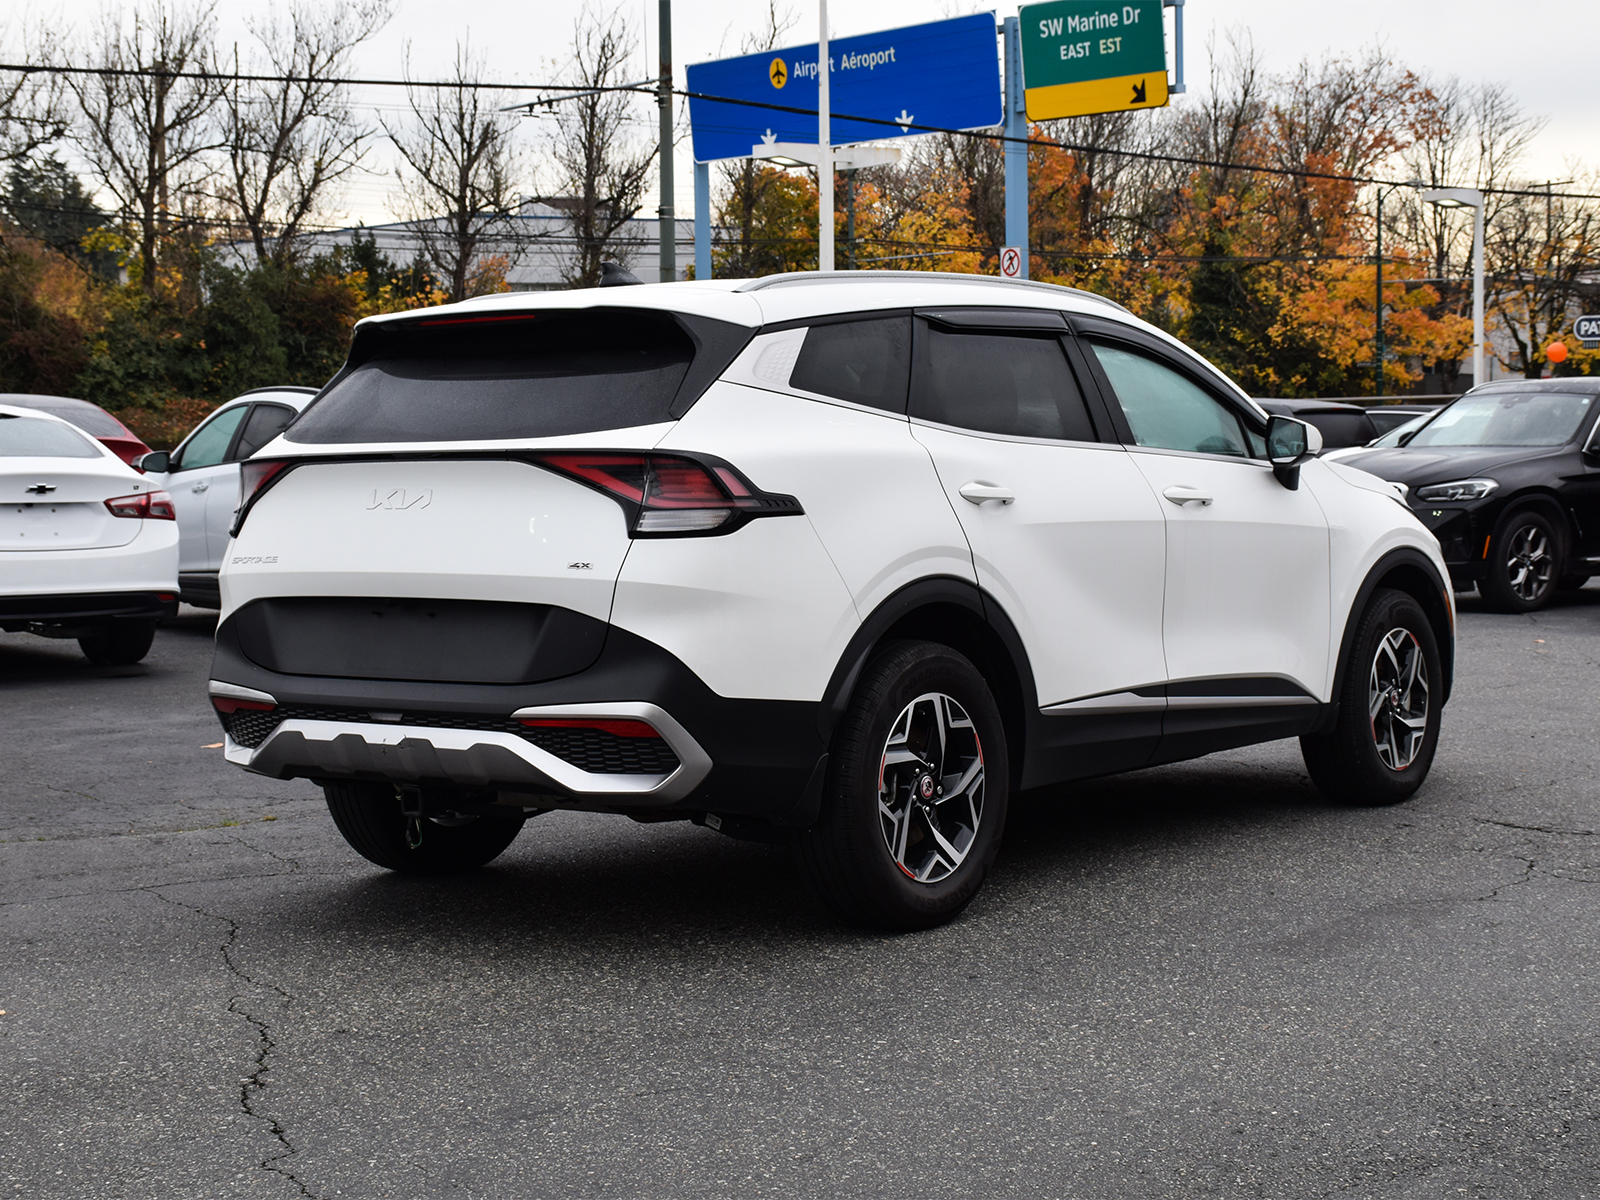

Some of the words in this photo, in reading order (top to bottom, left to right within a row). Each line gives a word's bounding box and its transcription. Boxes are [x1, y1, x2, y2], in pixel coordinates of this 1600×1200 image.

[1039, 17, 1063, 38] SW
[1067, 11, 1119, 34] Marine
[1122, 6, 1141, 25] Dr
[1060, 41, 1091, 60] EAST
[1099, 37, 1122, 54] EST
[793, 57, 835, 80] Airpt
[841, 46, 896, 71] Aéroport
[366, 488, 433, 510] KIA
